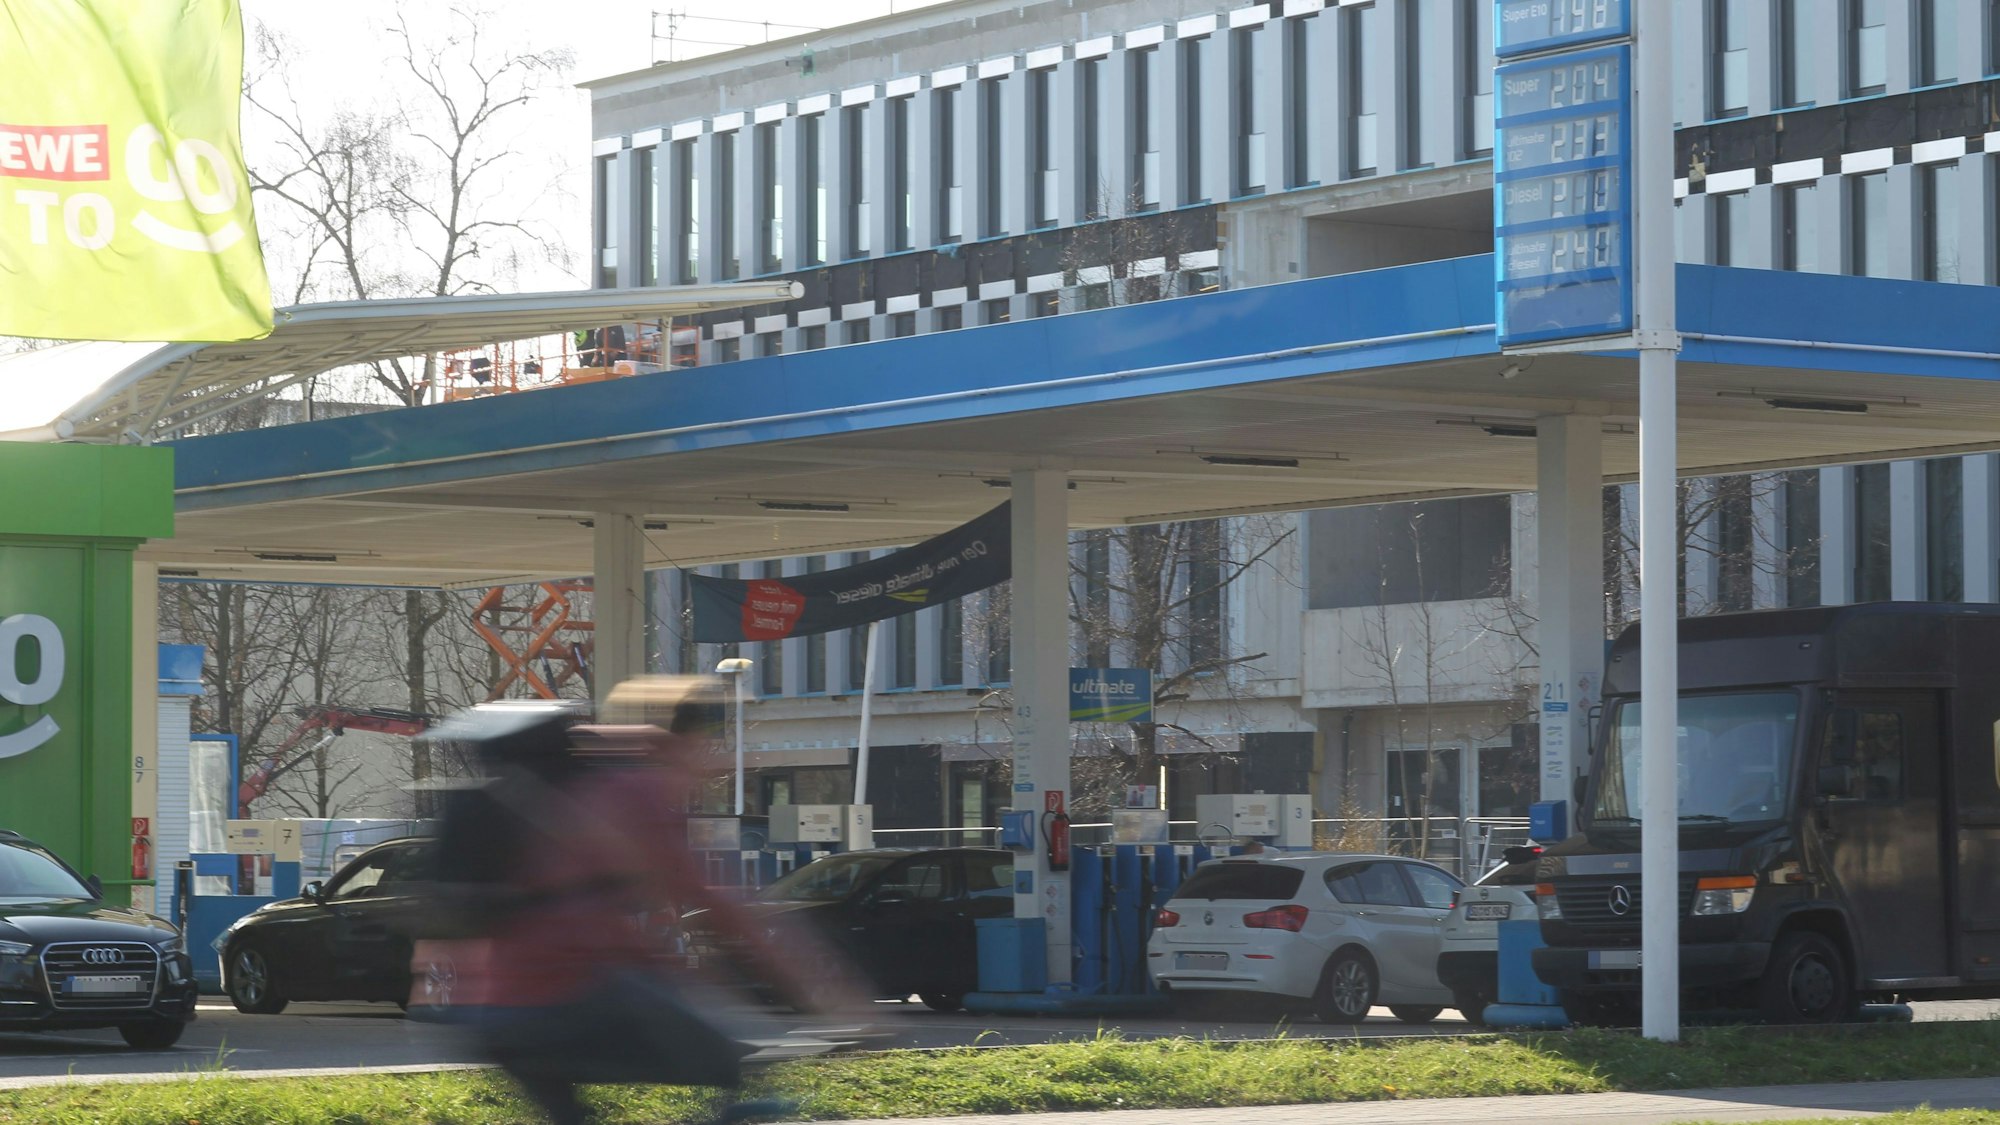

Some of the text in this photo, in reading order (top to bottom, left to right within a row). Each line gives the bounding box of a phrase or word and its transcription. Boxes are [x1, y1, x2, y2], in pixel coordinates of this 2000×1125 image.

[1502, 7, 1530, 23] Super
[1531, 4, 1547, 18] E10
[1504, 78, 1540, 97] Super
[1551, 62, 1609, 108] 204
[1505, 183, 1542, 206] Diesel
[15, 189, 115, 250] TO
[1552, 228, 1610, 273] 240
[1072, 677, 1136, 695] ultimate
[1543, 682, 1564, 700] 2 1
[135, 756, 144, 768] 8
[135, 771, 144, 783] 7
[856, 814, 864, 825] 5
[1295, 807, 1302, 819] 3
[282, 828, 293, 844] 7
